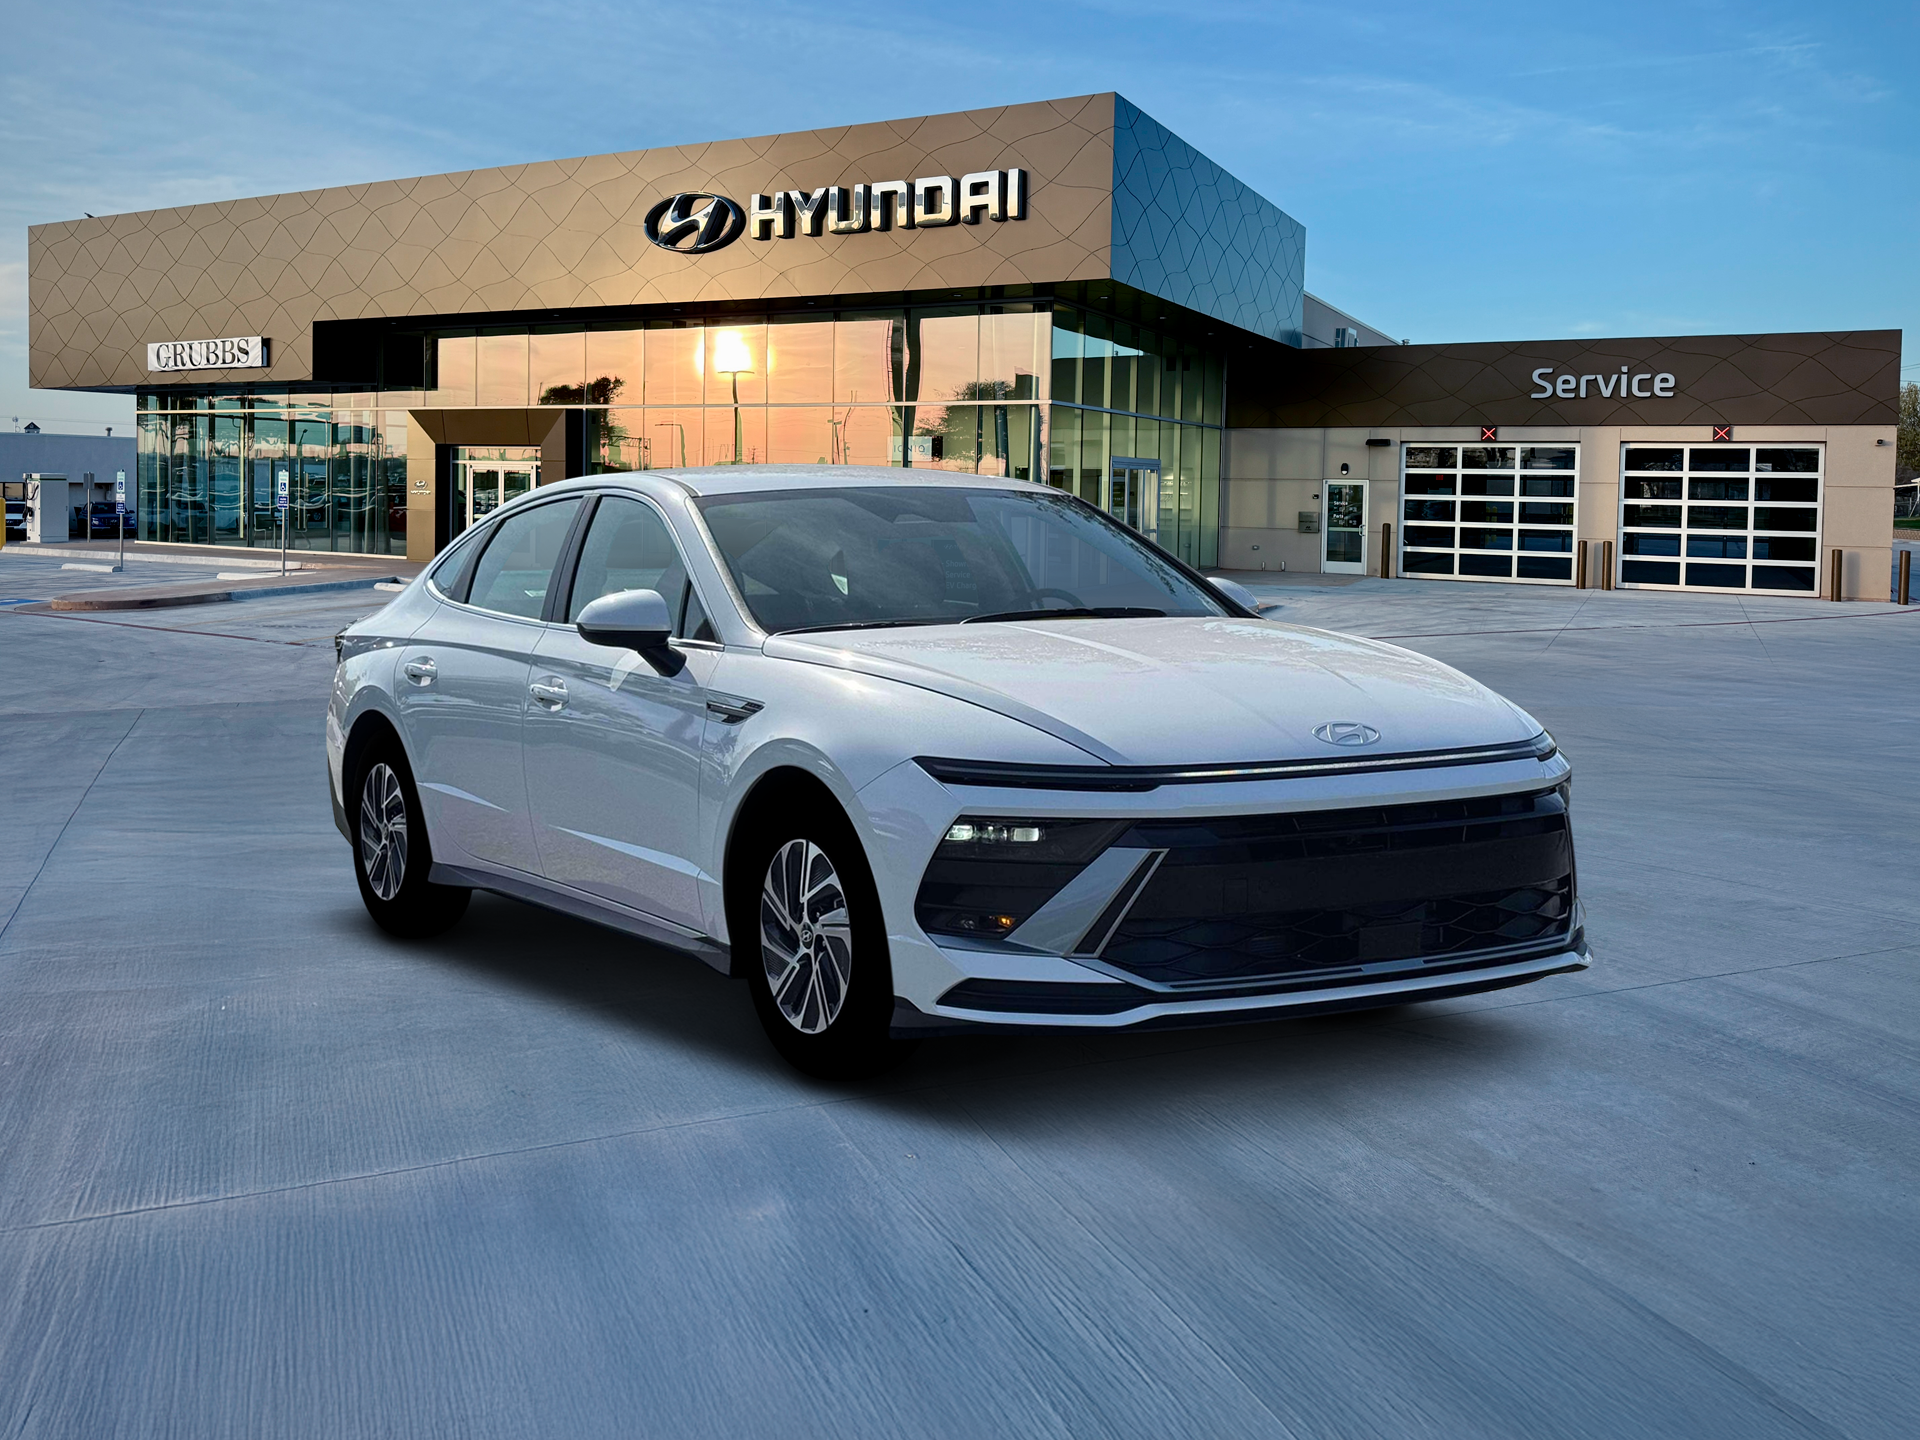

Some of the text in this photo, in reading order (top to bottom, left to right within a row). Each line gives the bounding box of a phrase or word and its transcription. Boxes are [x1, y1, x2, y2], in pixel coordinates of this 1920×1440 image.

[750, 168, 1023, 239] HYUNDAI
[156, 339, 250, 368] GRUBBS
[1531, 365, 1676, 398] Service
